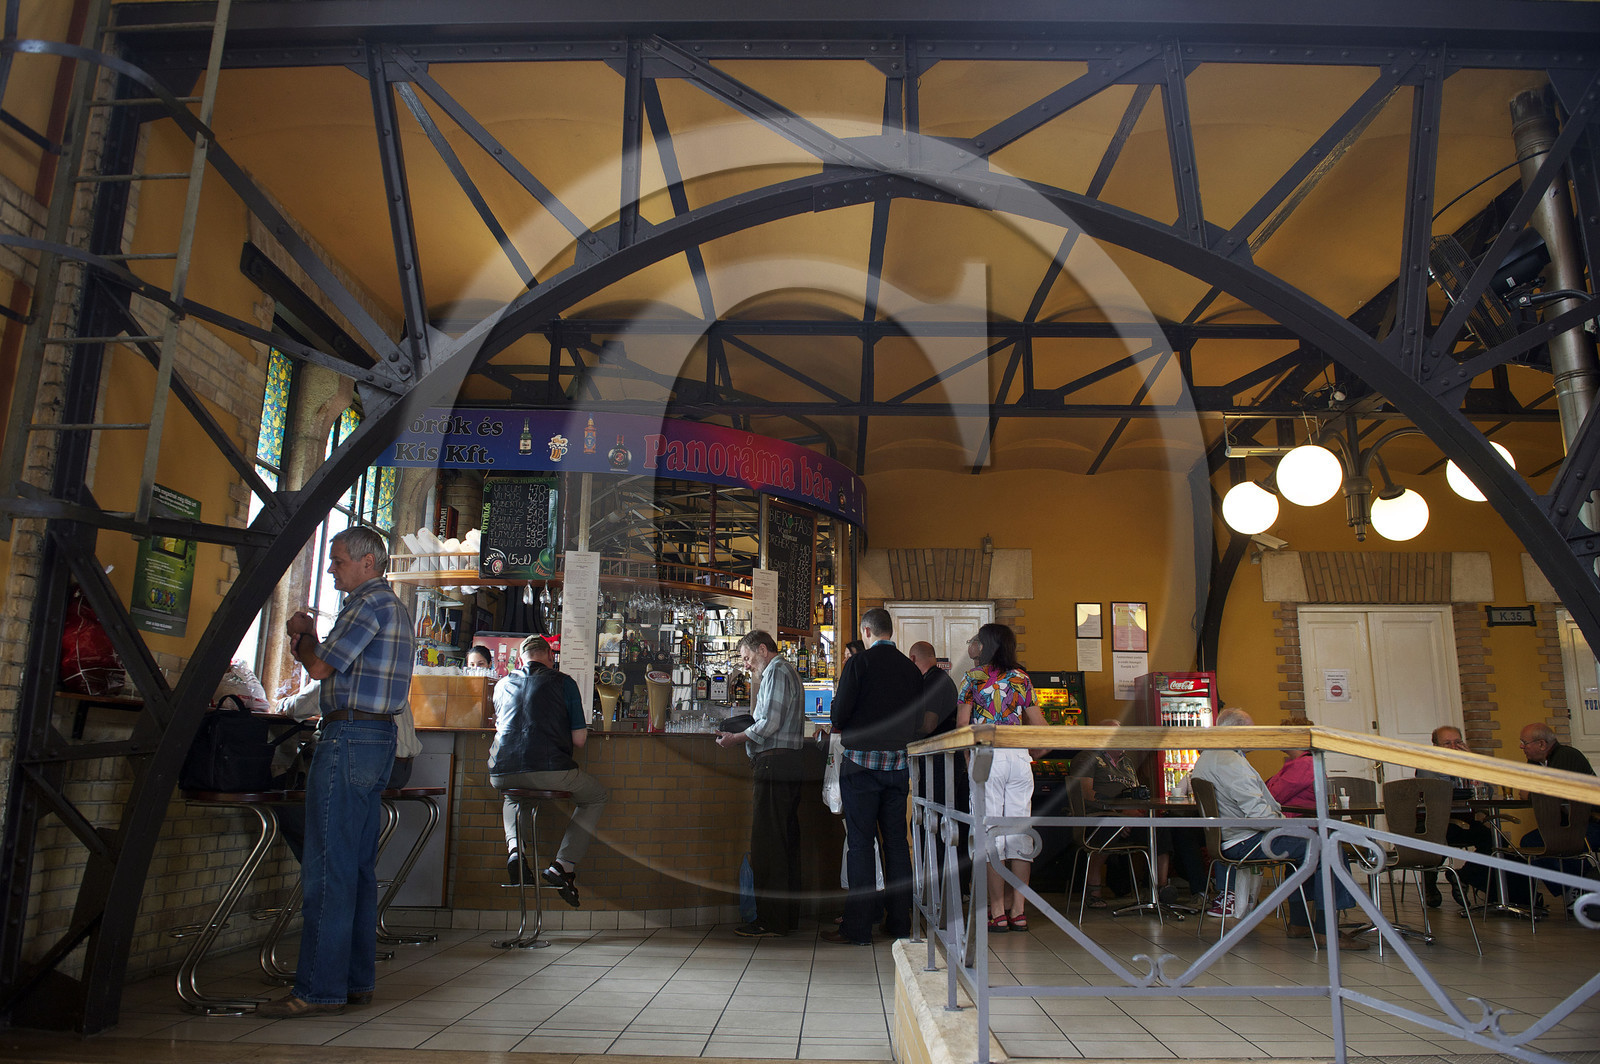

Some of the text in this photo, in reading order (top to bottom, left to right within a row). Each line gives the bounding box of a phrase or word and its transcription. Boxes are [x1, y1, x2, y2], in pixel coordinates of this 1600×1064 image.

[476, 416, 503, 436] és
[394, 441, 495, 464] Kis Kft.
[643, 434, 833, 503] Panoráma bár
[1500, 611, 1525, 621] K.35.
[1169, 680, 1195, 691] Coca-Cola
